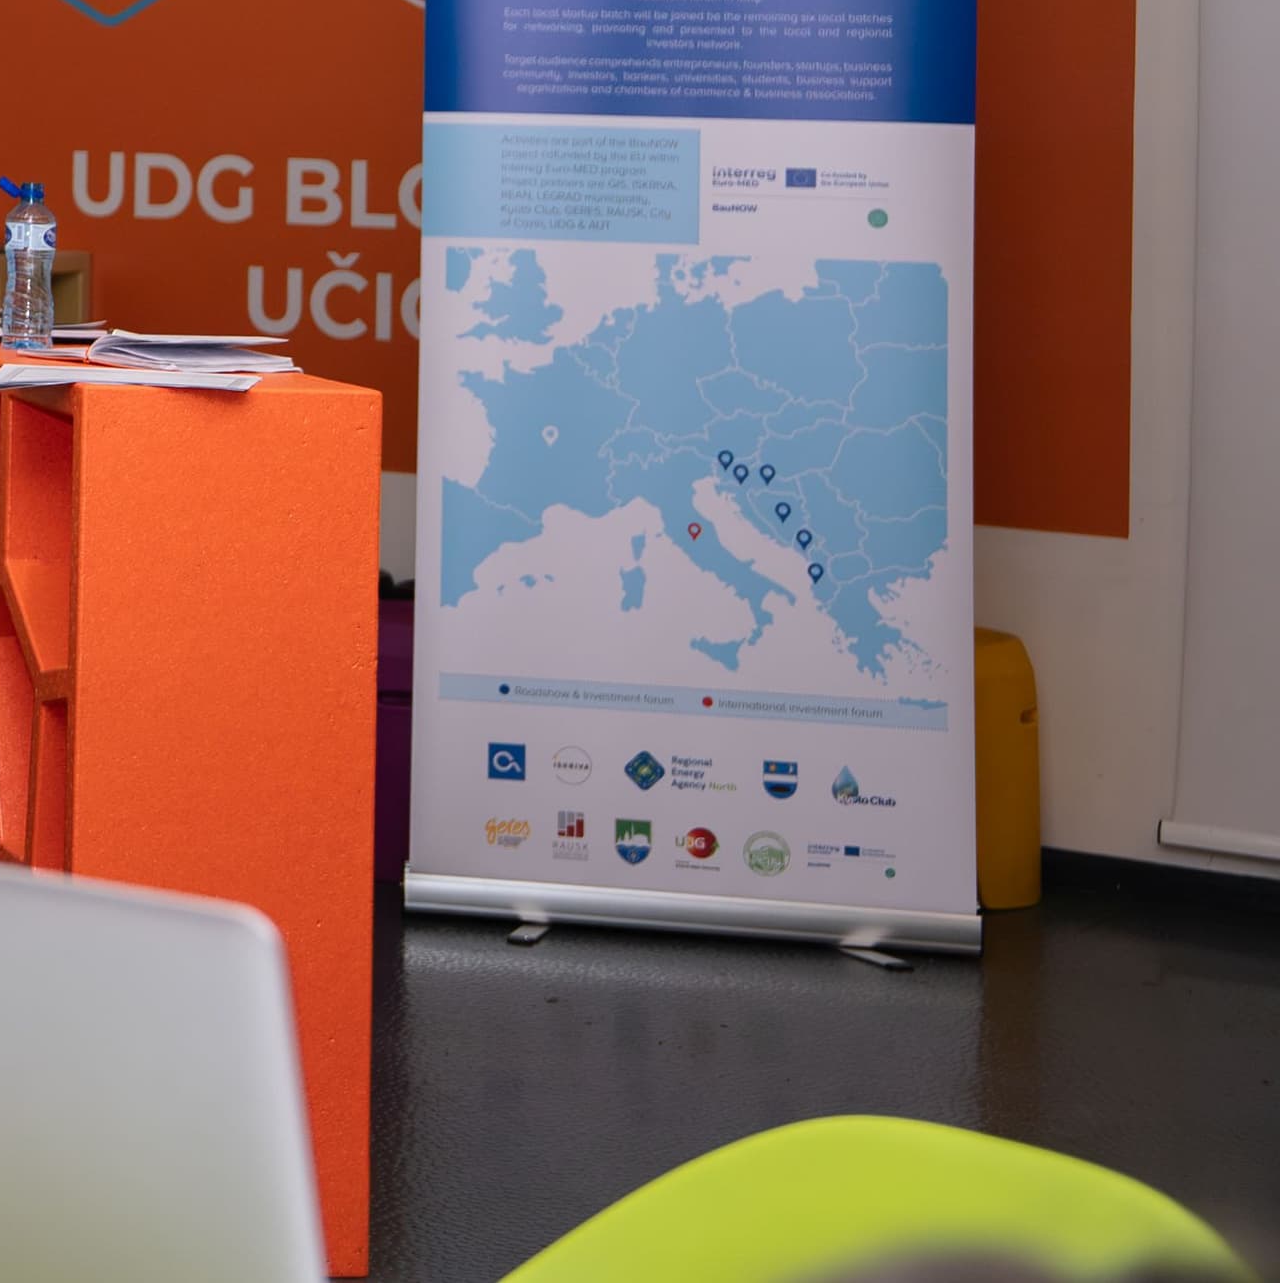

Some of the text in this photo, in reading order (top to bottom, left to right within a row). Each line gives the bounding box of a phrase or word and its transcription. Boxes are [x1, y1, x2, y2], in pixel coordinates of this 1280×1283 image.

[72, 150, 254, 224] UDG
[712, 204, 758, 213] BauNOW
[671, 755, 712, 767] Regional
[671, 767, 705, 779] Energy
[671, 779, 706, 791] Agency
[870, 796, 896, 807] Club
